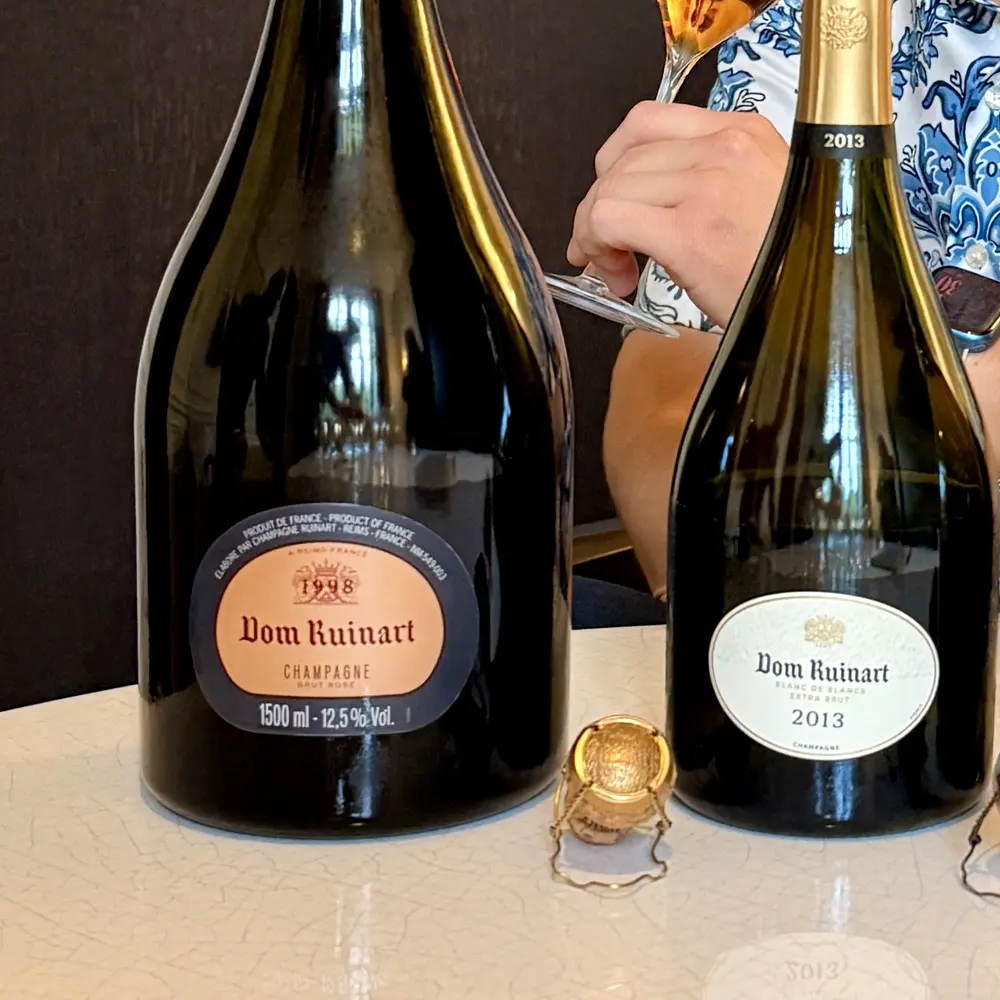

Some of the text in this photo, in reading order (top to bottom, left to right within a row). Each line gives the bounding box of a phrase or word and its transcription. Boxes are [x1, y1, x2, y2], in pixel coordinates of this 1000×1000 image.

[824, 133, 865, 149] 2013
[242, 519, 275, 538] PRODUIT
[276, 517, 289, 528] DE
[289, 513, 322, 525] FRANCE
[328, 513, 369, 525] PRODUCT
[370, 518, 382, 528] OF
[382, 521, 416, 541] FRANCE
[252, 525, 300, 546] CHAMPAGNE
[300, 523, 337, 533] RUINART
[343, 524, 369, 536] REIMS
[374, 528, 408, 548] FRANCE
[302, 578, 354, 595] 1998
[239, 616, 415, 646] Dom Ruinart
[283, 664, 371, 680] CHAMPAGNE
[755, 652, 890, 684] Dom Ruinart
[775, 681, 807, 692] BLANC
[259, 703, 290, 728] 1500
[293, 705, 310, 728] ml
[370, 706, 395, 727] Vol.
[791, 708, 845, 729] 2013
[792, 741, 840, 751] CHAMPAGNE
